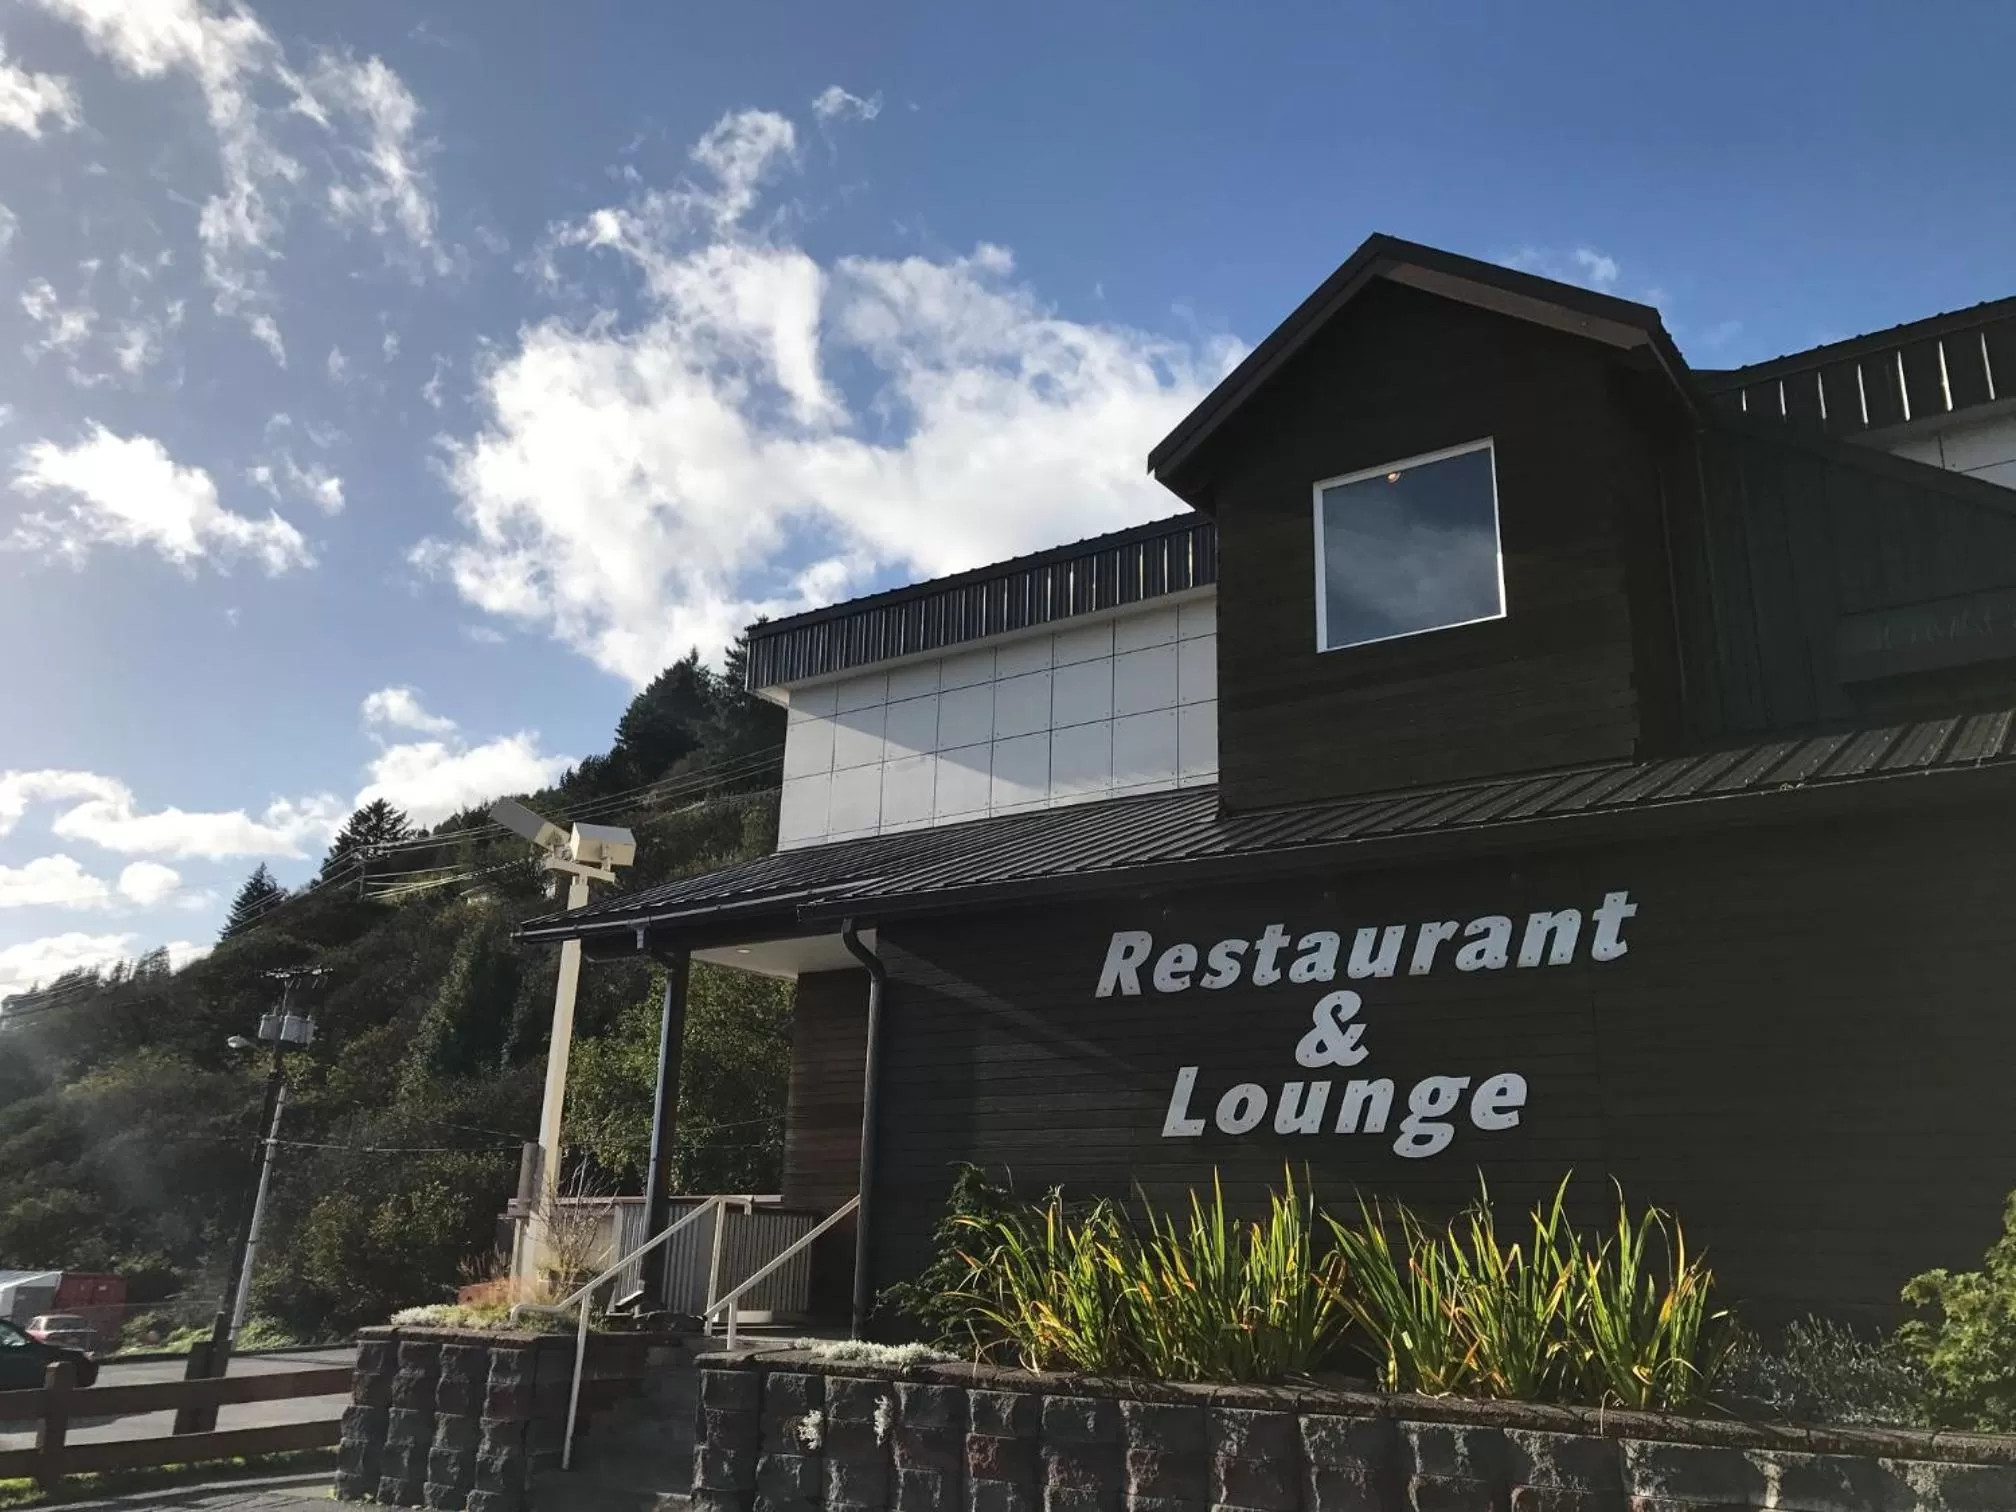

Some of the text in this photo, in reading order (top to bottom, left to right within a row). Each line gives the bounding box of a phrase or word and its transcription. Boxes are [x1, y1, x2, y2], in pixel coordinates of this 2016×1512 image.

[1095, 891, 1638, 998] Restaurant
[1295, 990, 1369, 1068] &
[1161, 1066, 1528, 1158] Lounge
